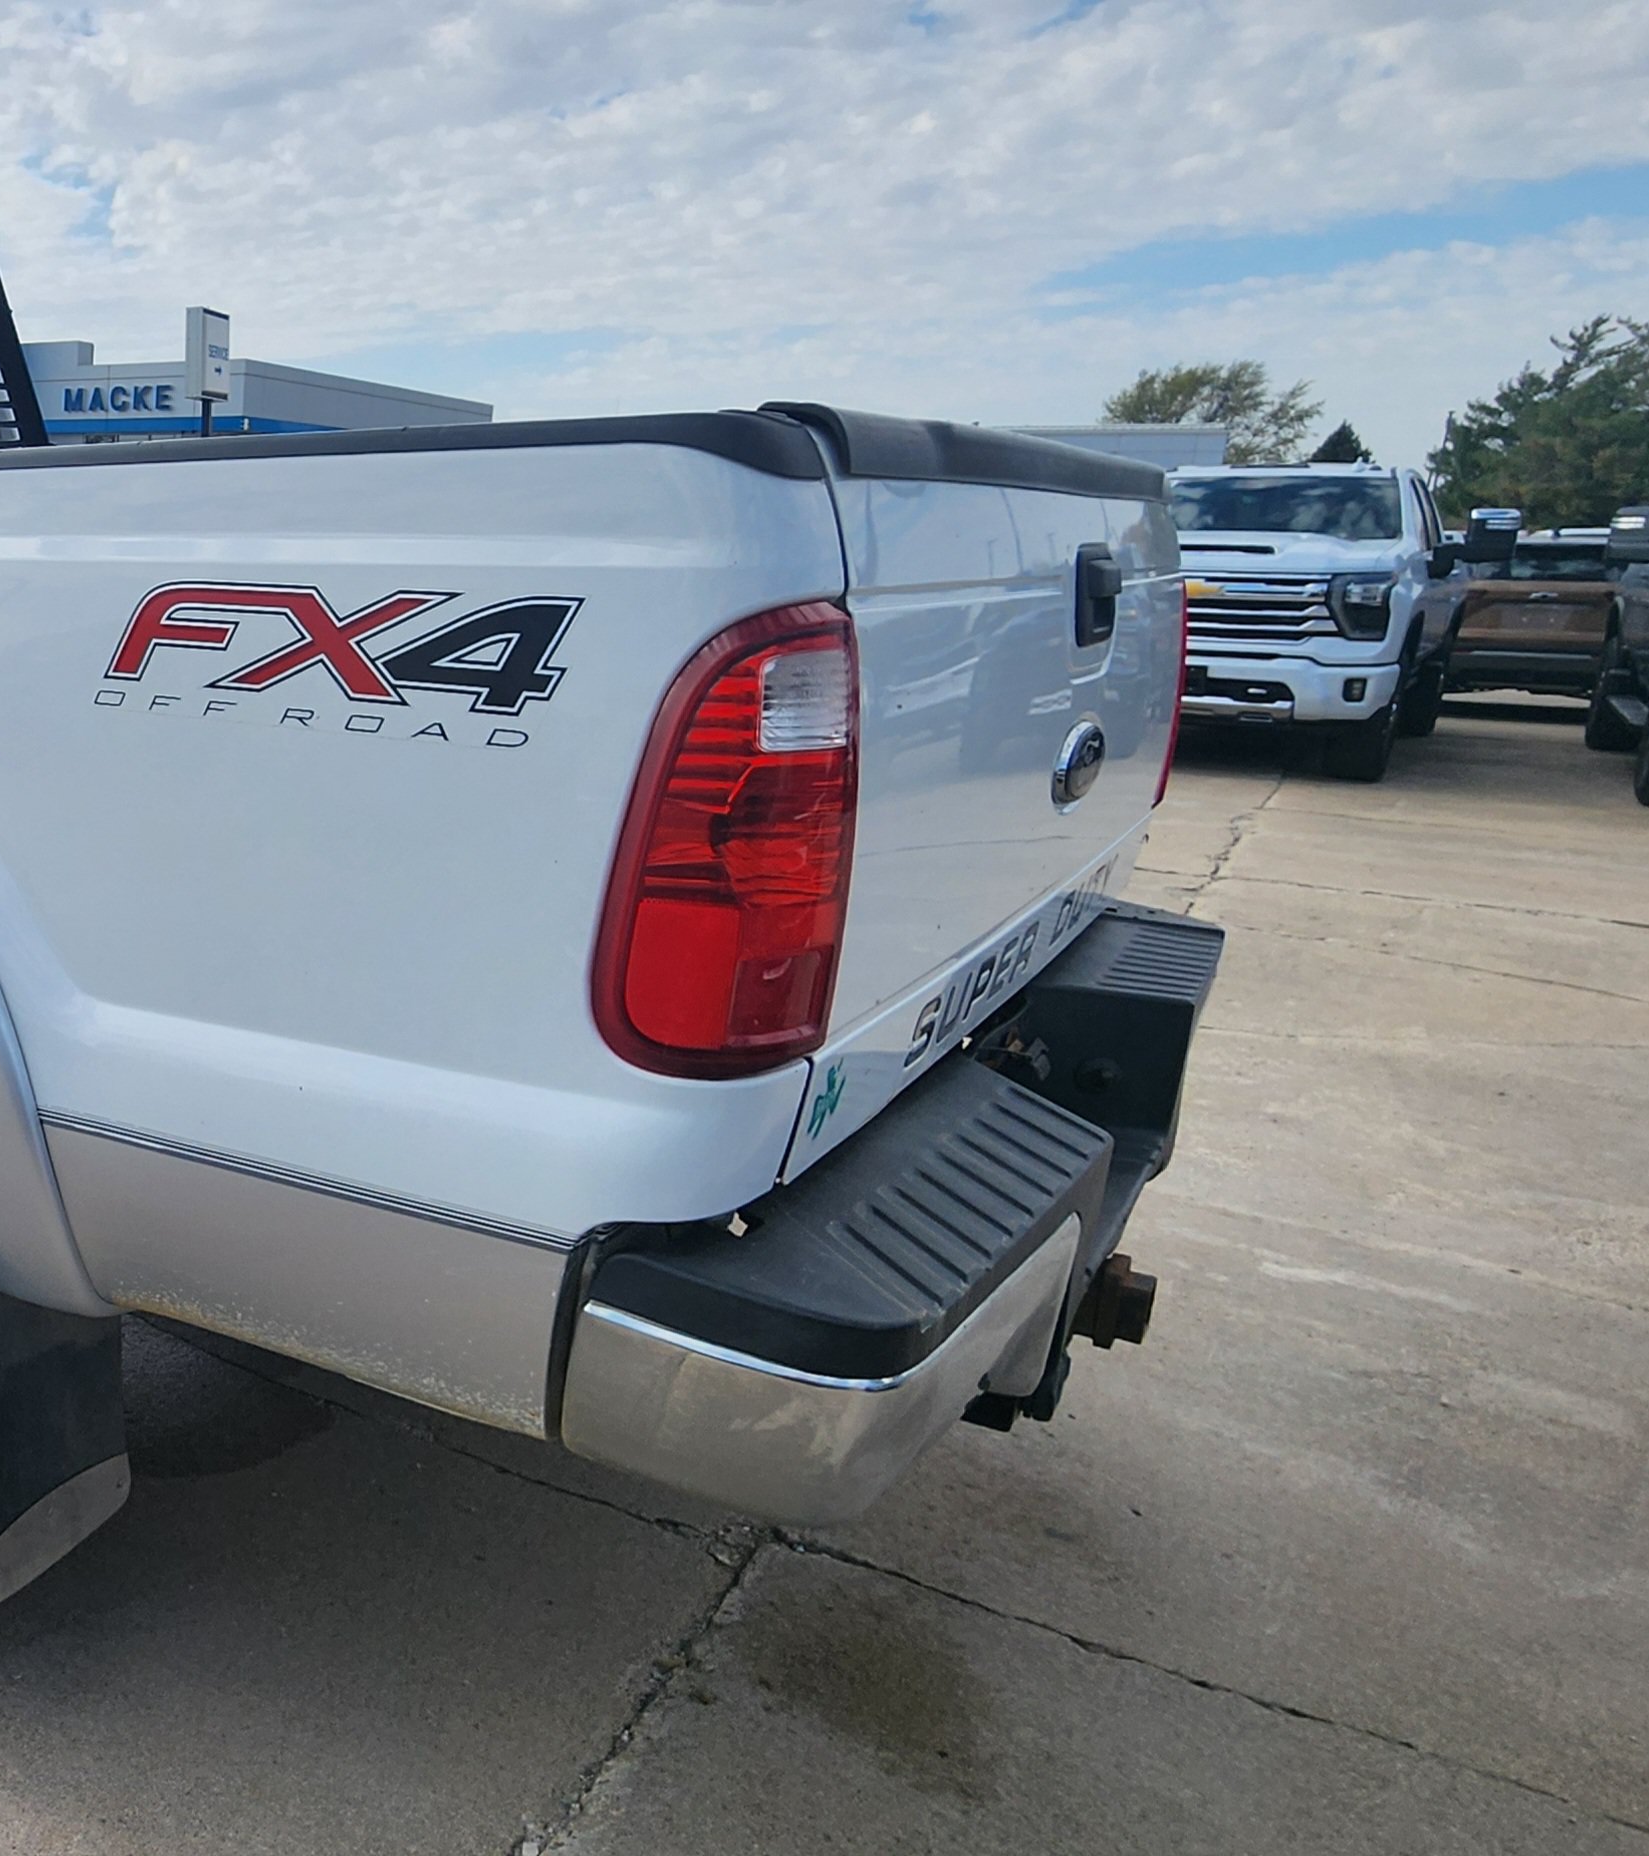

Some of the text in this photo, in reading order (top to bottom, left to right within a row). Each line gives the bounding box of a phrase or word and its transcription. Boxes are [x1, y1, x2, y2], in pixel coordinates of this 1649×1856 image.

[63, 385, 174, 412] MACKE
[103, 580, 586, 716] FX4
[94, 690, 529, 748] OFF ROAD
[903, 920, 1040, 1068] SUPER
